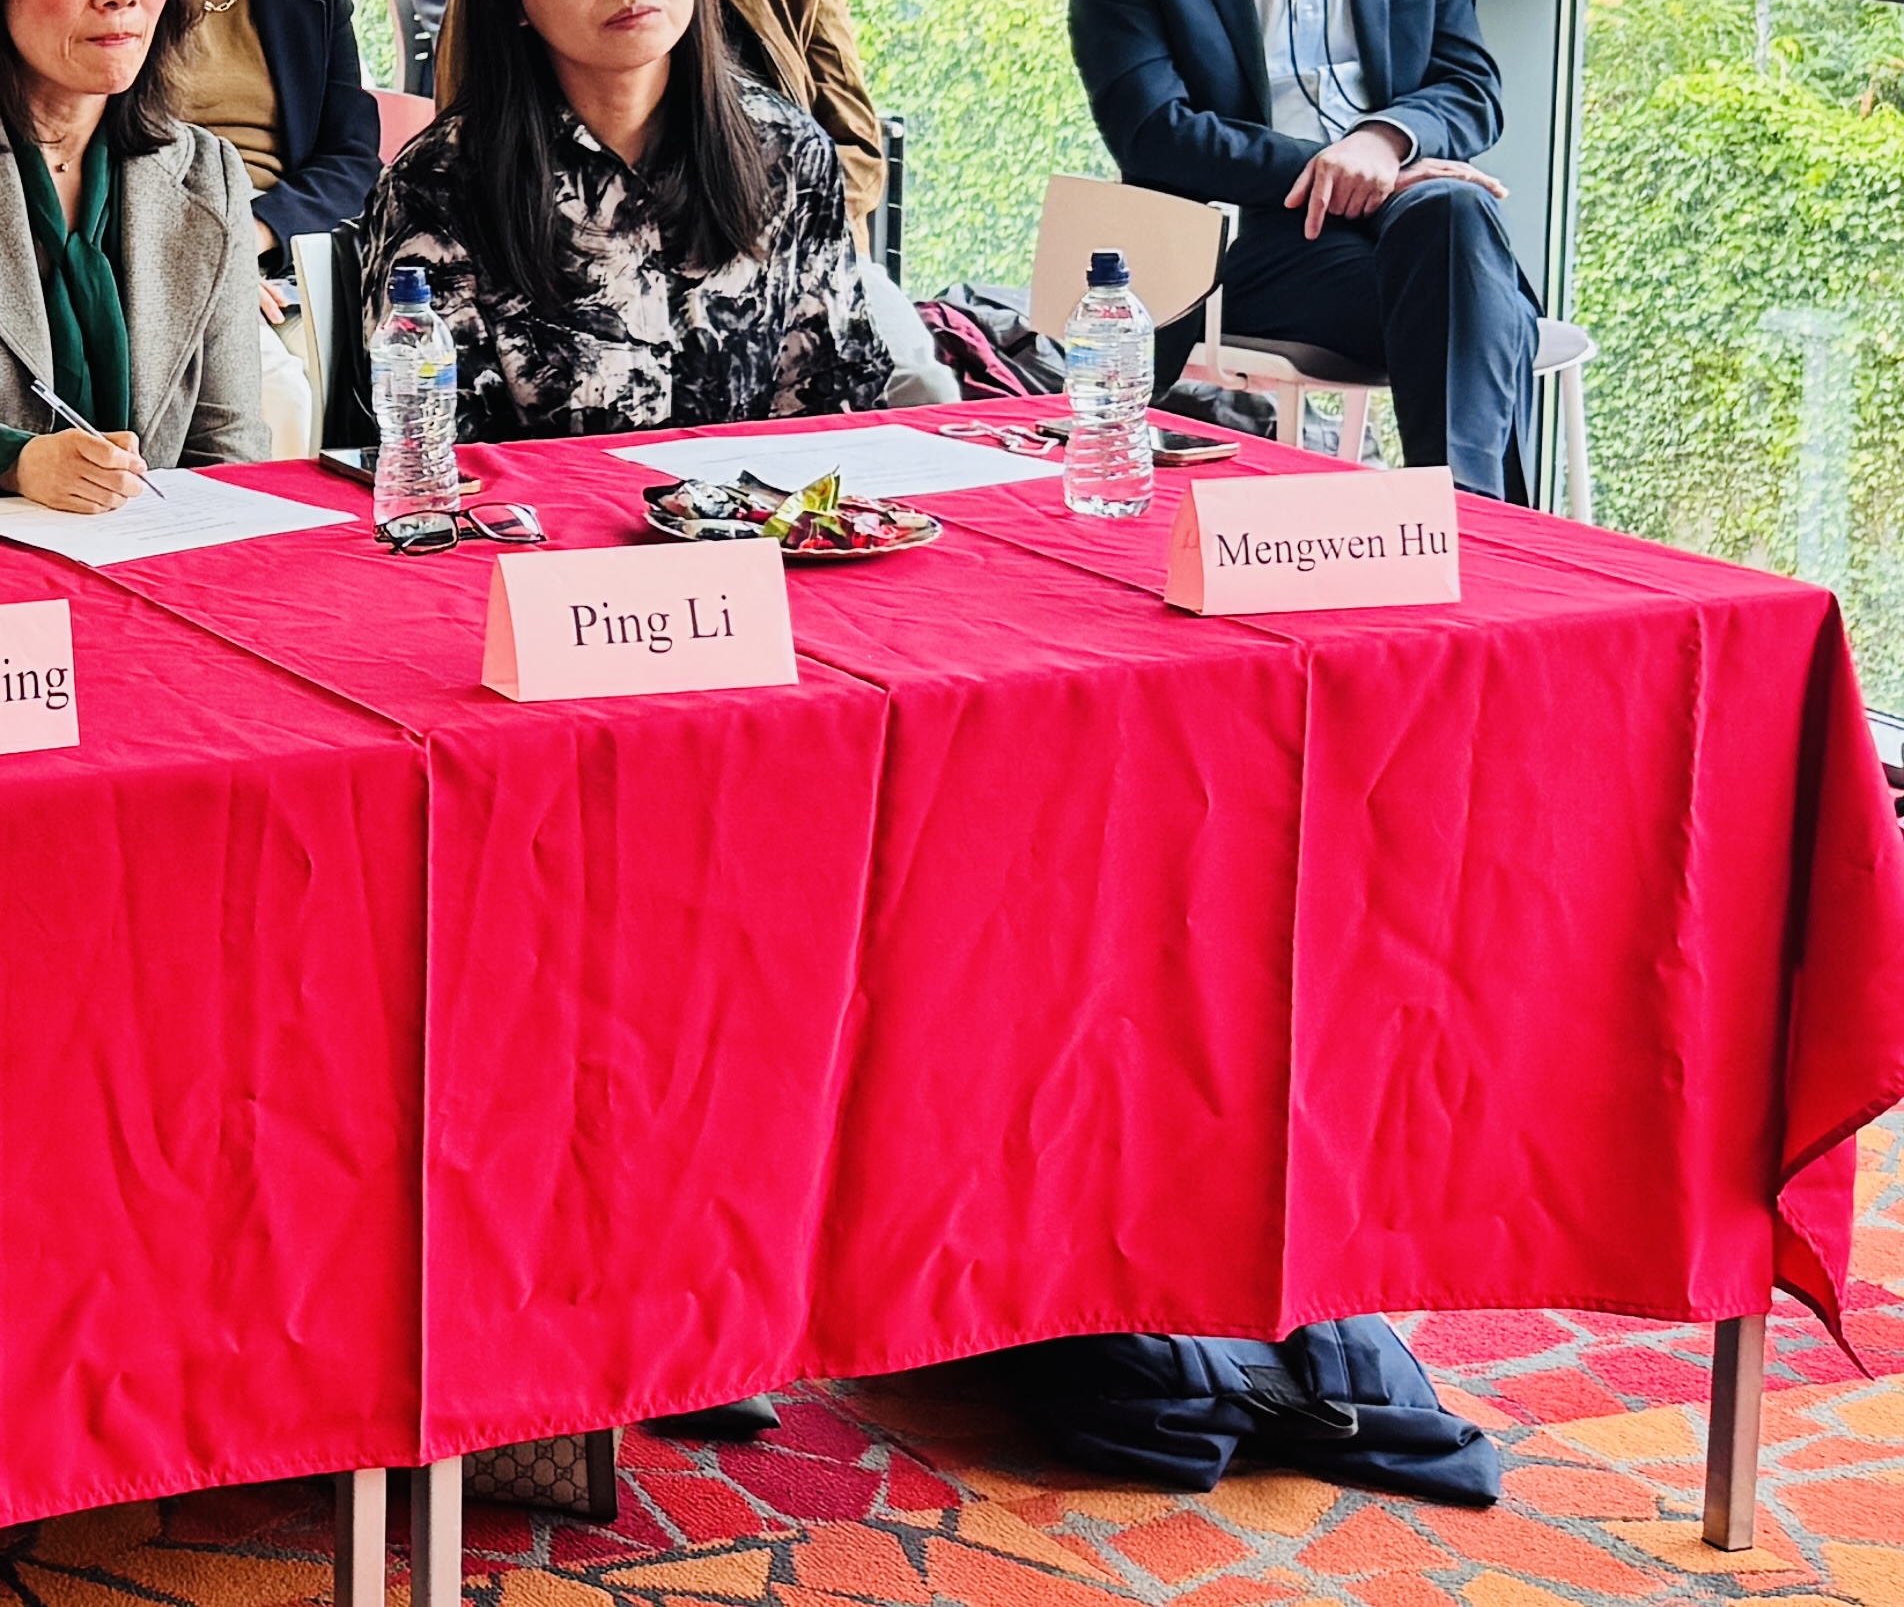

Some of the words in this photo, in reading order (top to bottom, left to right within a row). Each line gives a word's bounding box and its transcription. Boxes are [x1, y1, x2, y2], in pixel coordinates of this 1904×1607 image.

[1216, 532, 1386, 572] Mengwen
[1398, 522, 1449, 558] Hu
[570, 602, 673, 654] Ping
[683, 594, 735, 640] Li
